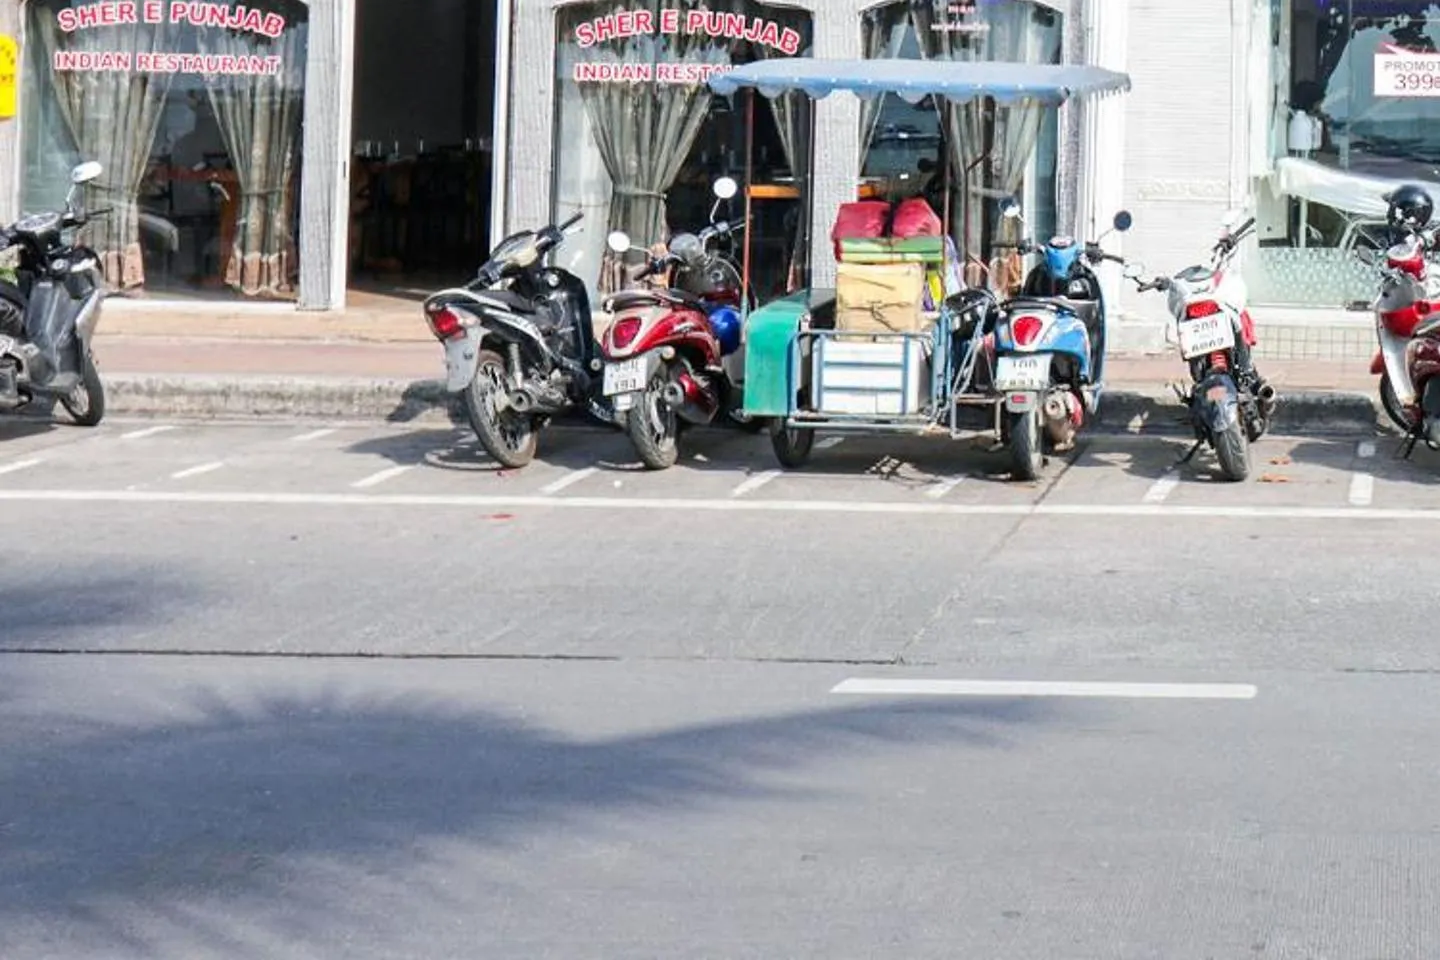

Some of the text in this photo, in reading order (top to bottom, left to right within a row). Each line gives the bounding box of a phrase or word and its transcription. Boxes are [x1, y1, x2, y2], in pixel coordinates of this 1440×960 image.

[58, 0, 285, 38] SHER E PUNJAB
[576, 8, 800, 55] SHER E PUNJAB
[54, 52, 281, 75] INDIAN RESTAURANT
[574, 63, 651, 82] INDIAN
